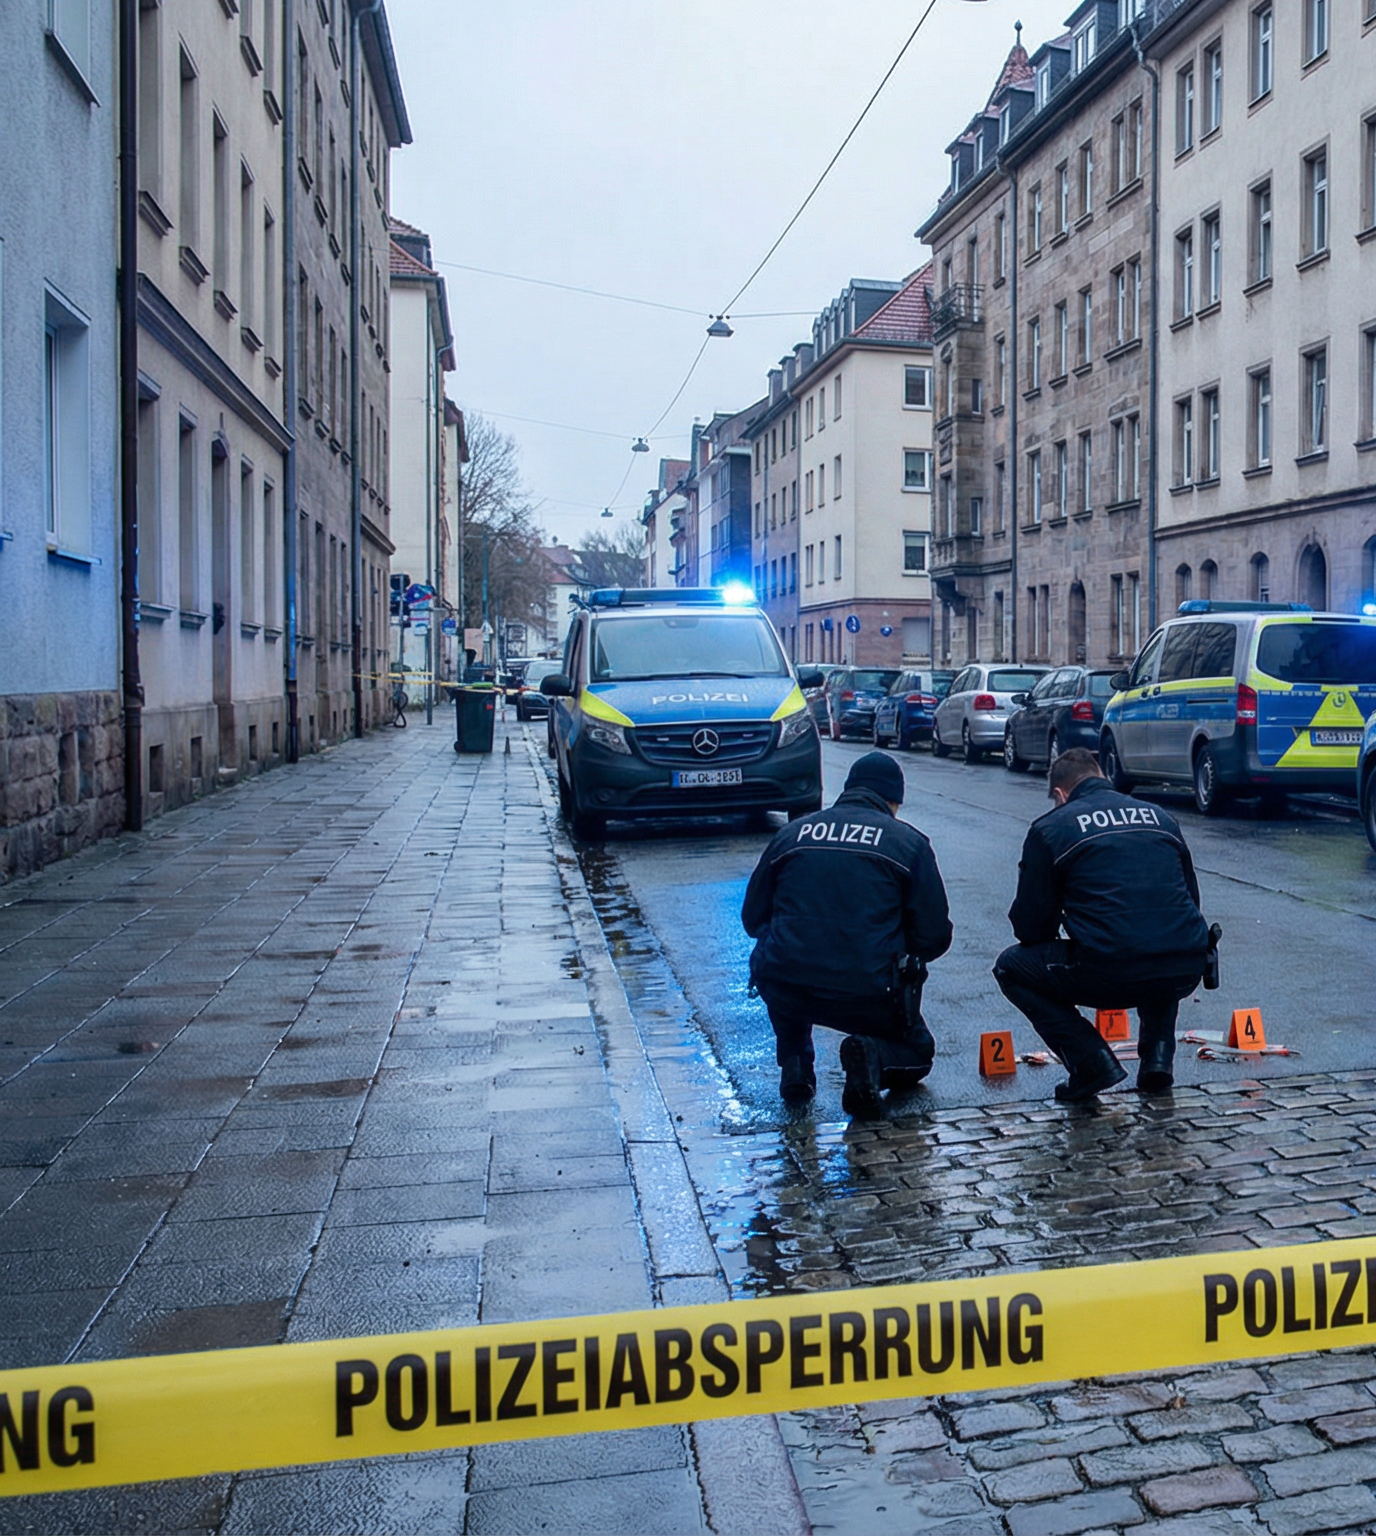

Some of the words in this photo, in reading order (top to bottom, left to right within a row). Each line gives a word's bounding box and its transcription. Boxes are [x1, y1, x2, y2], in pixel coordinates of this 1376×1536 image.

[652, 693, 749, 705] POLIZEI
[1076, 807, 1161, 833] POLIZEI
[796, 822, 883, 847] POLIZEI
[1245, 1014, 1256, 1041] 4
[991, 1037, 1005, 1062] 2
[336, 1293, 1043, 1438] POLIZEIABSPERRUNG
